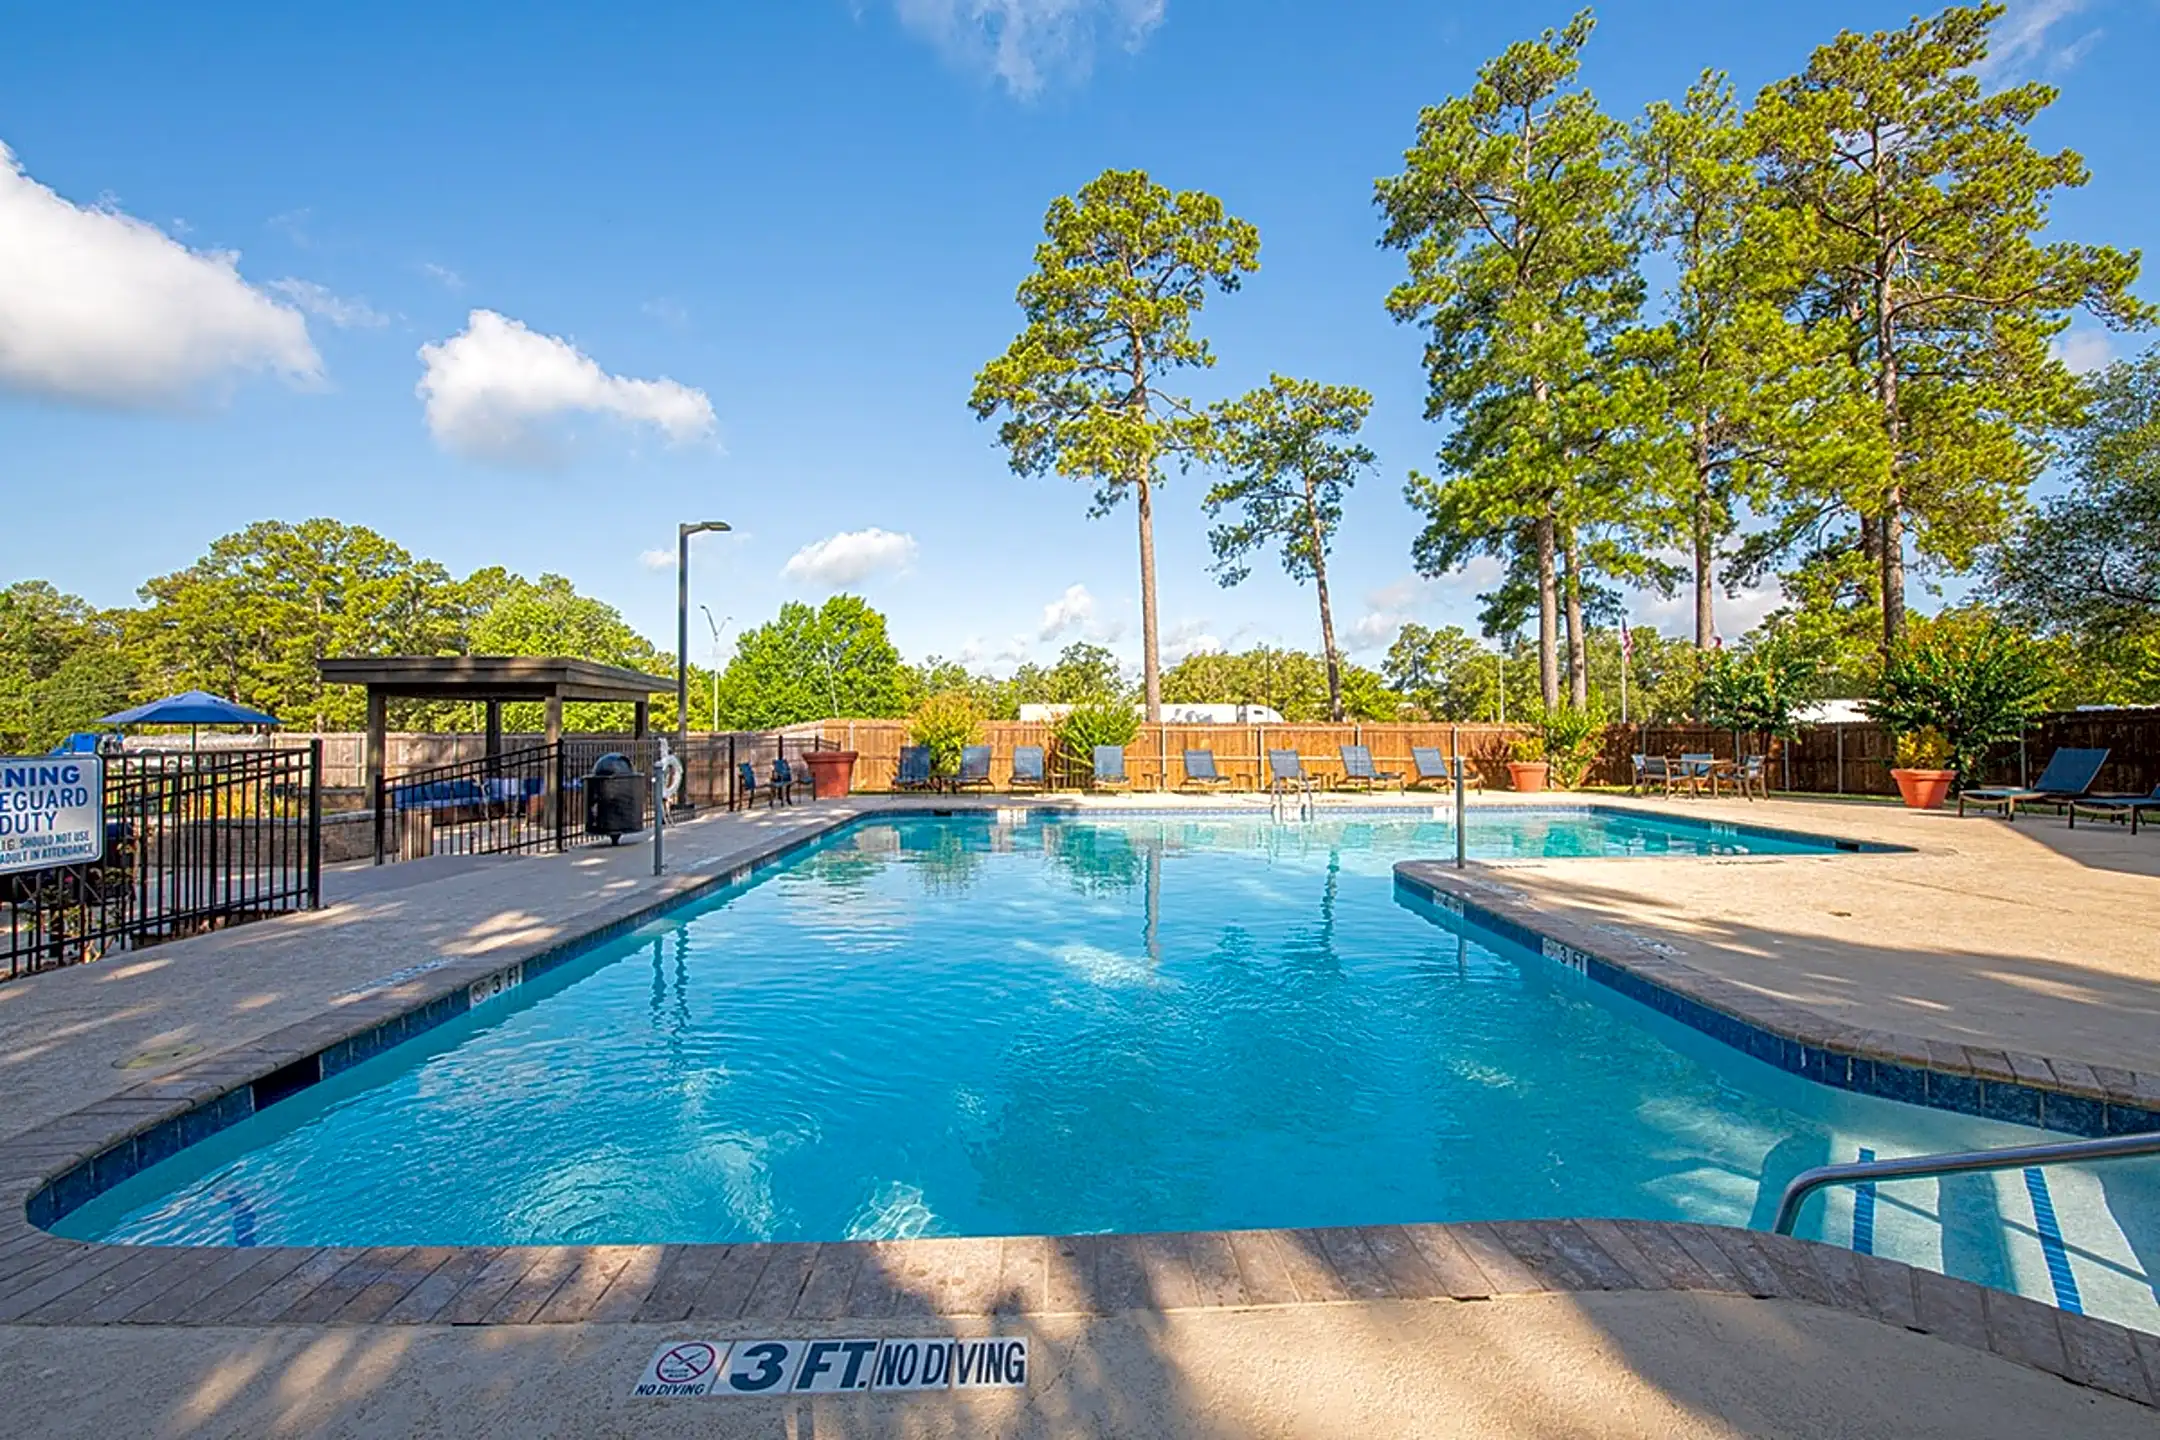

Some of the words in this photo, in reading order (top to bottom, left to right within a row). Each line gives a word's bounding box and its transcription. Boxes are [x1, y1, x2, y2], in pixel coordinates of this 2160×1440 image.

[0, 765, 80, 788] NING
[0, 811, 57, 835] DUTY
[56, 832, 72, 844] NOT
[730, 1342, 788, 1391] 3
[795, 1341, 877, 1389] FT.
[876, 1343, 918, 1386] NO
[921, 1341, 1025, 1385] DIVING
[635, 1384, 656, 1396] NO
[657, 1383, 705, 1396] DIVING
